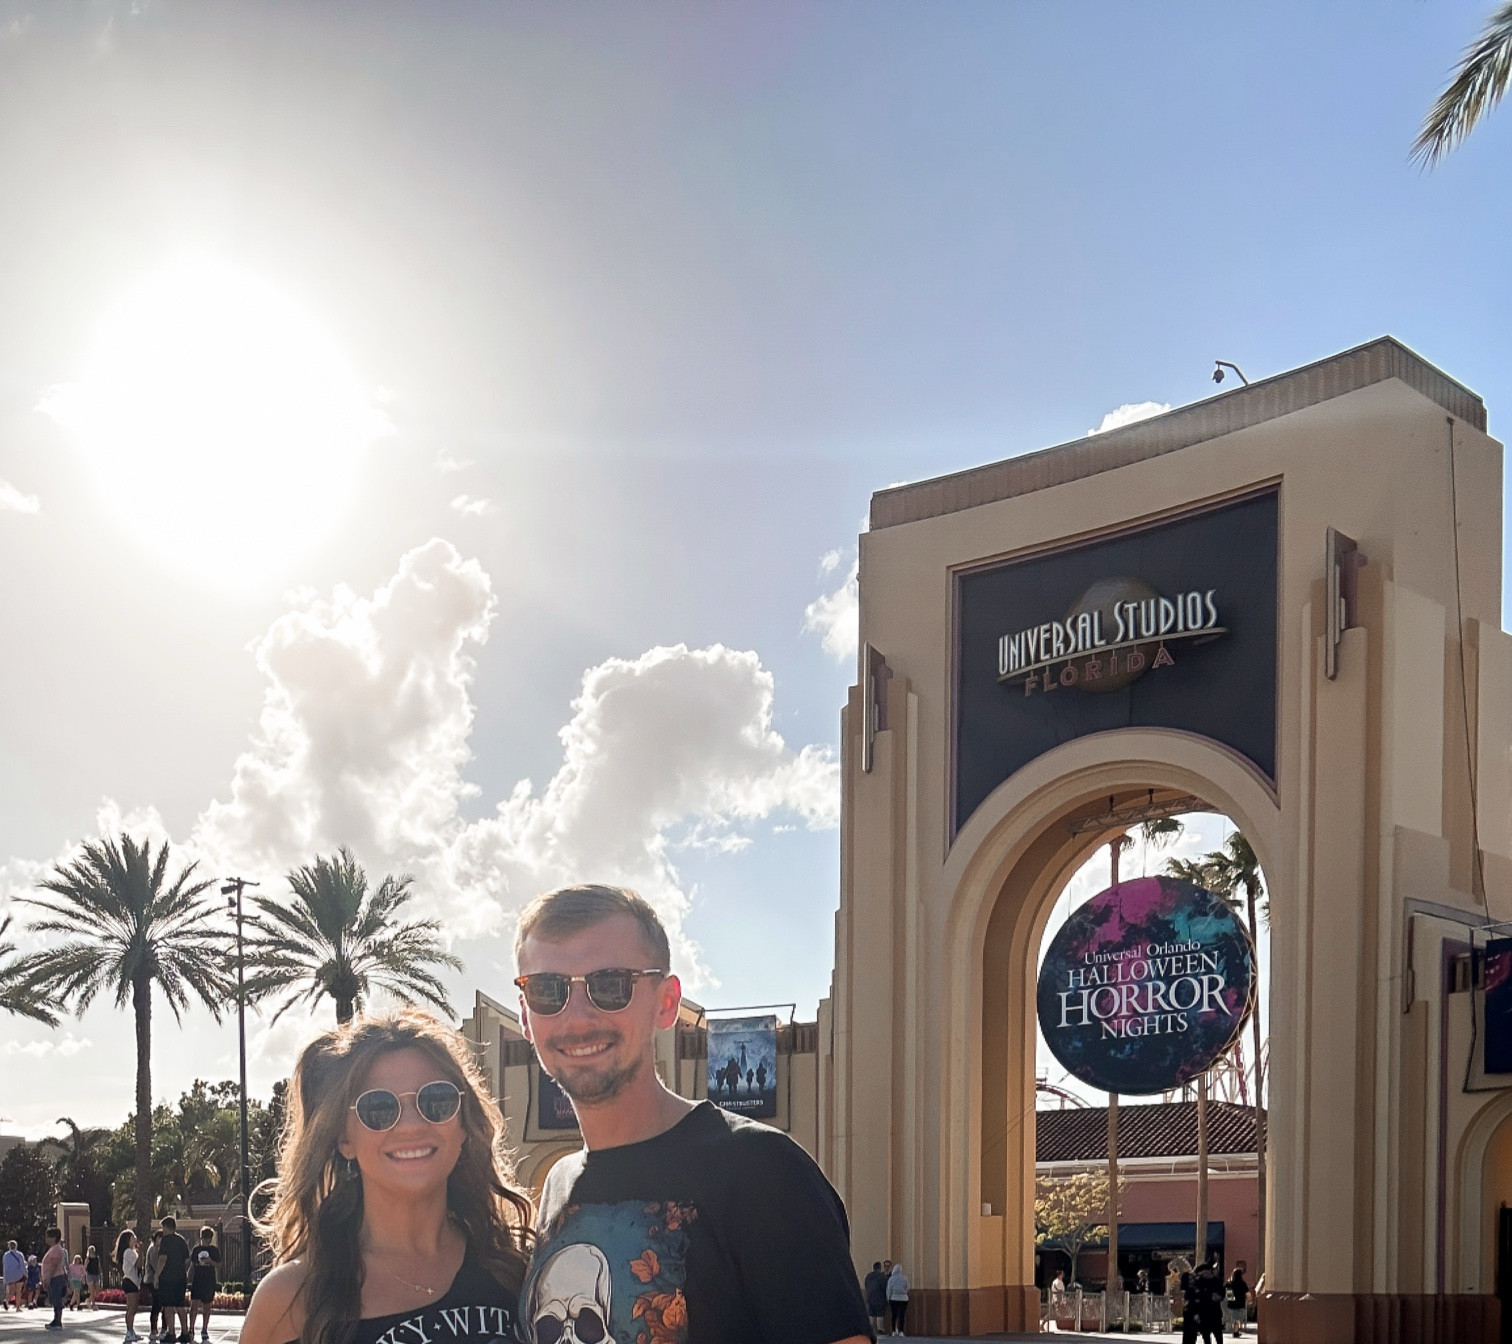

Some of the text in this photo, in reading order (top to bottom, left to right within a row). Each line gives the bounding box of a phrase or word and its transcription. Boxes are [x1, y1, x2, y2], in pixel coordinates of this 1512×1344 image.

[998, 589, 1218, 675] UNIVERSAL STUDIOS
[1024, 647, 1175, 697] FLORIDA
[1067, 950, 1219, 988] HALLOWEEN
[1084, 939, 1201, 965] Universal Orlando
[1056, 974, 1232, 1028] HORROR
[1100, 1012, 1189, 1040] NIGHTS
[439, 1305, 511, 1337] WIT
